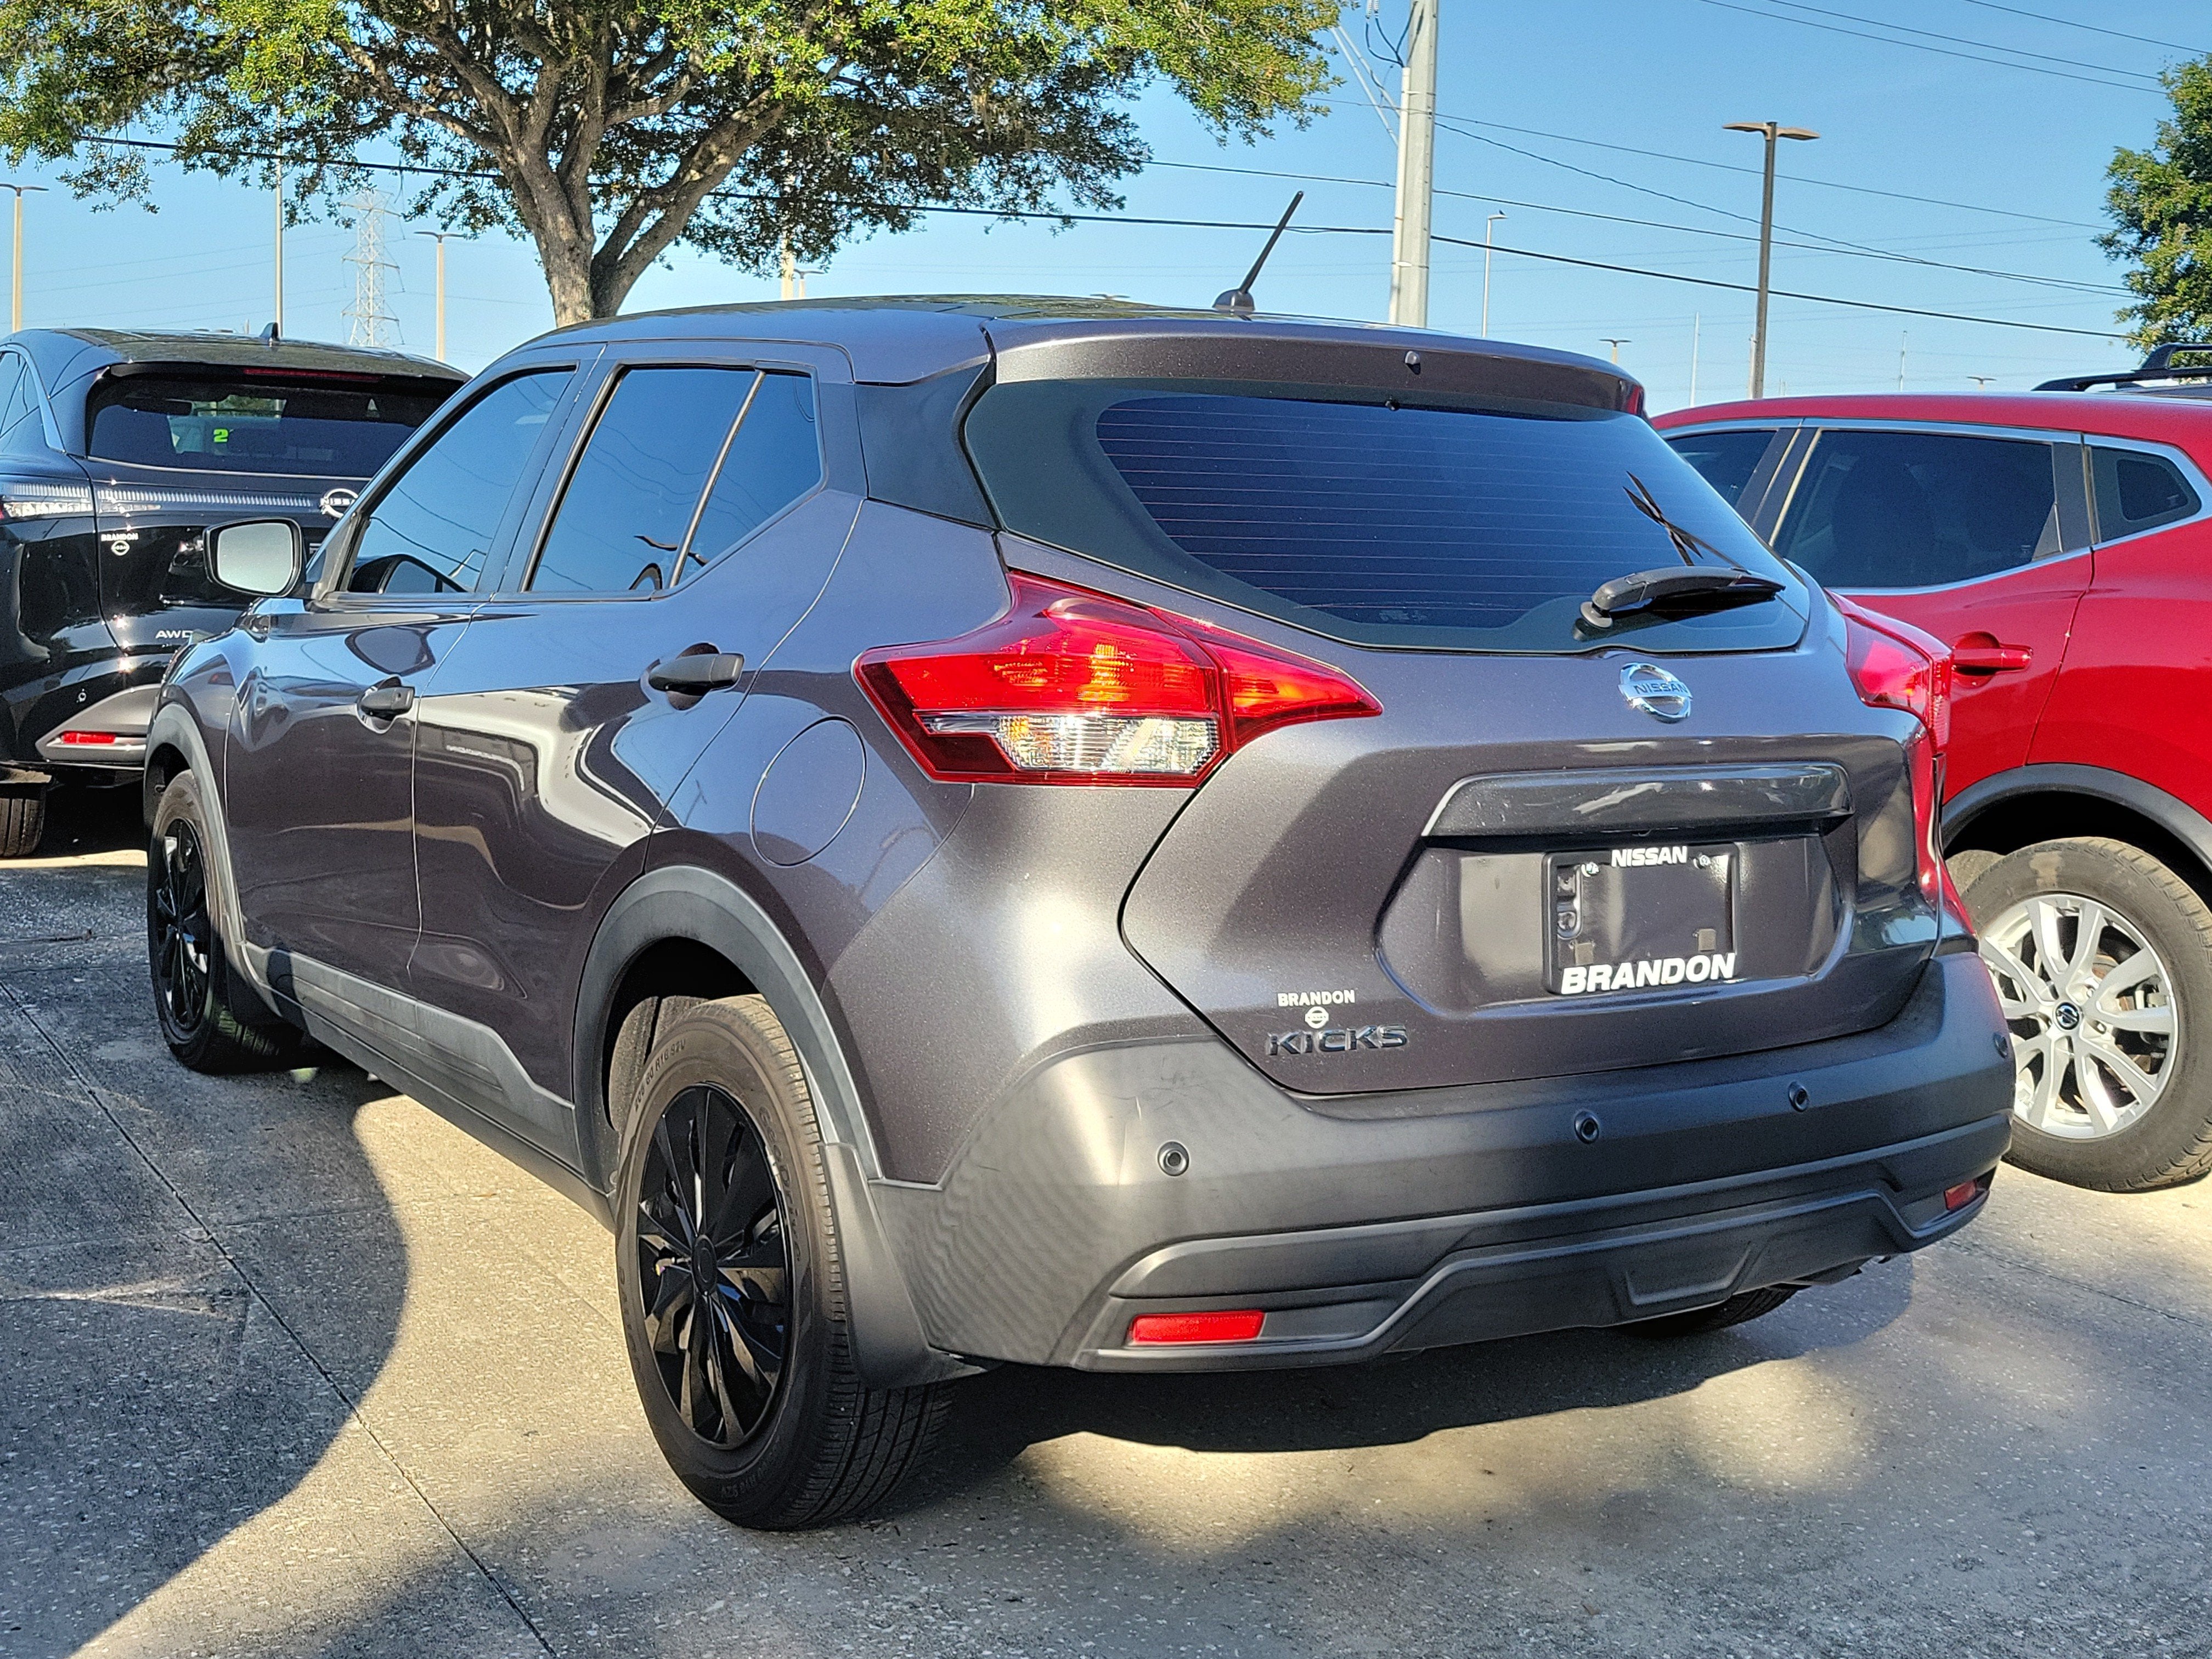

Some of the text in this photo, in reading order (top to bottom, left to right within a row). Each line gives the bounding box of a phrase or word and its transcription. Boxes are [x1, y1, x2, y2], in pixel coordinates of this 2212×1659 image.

[213, 428, 229, 443] 2
[155, 630, 193, 639] AWD
[1633, 681, 1689, 695] NISSAN
[1611, 845, 1688, 867] NISSAN
[1561, 952, 1736, 995] BRANDON
[1277, 989, 1356, 1007] BRANDON
[1266, 1024, 1409, 1056] KICKS
